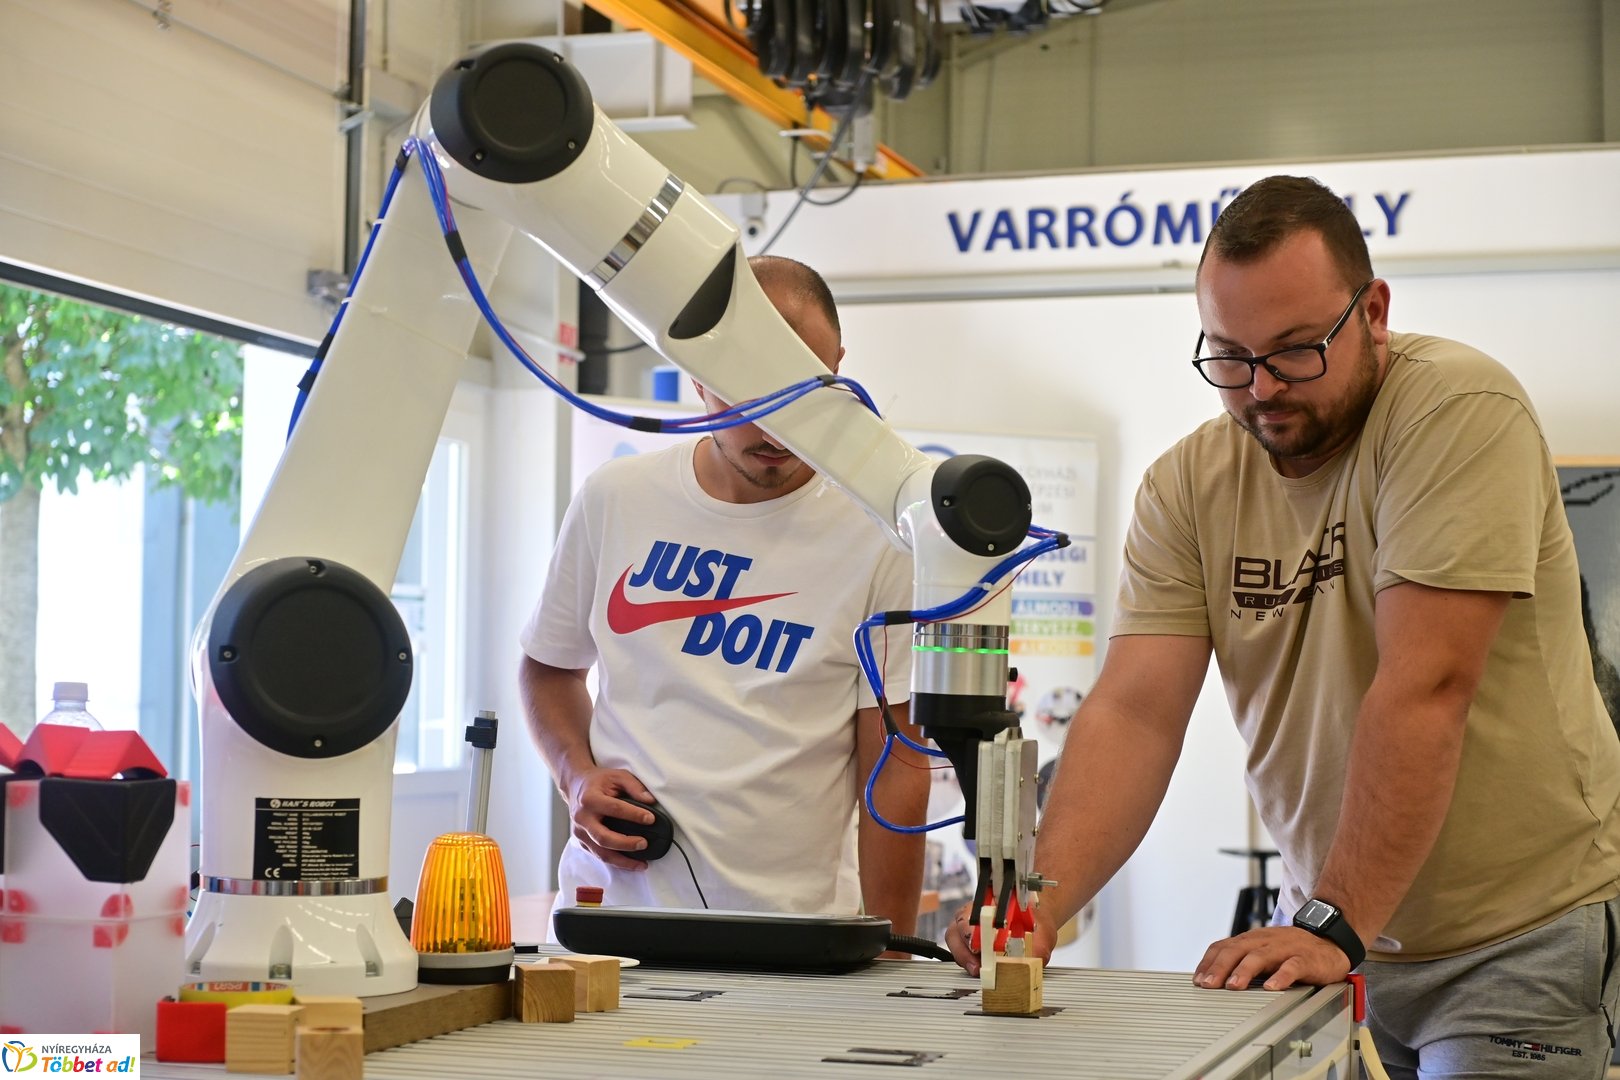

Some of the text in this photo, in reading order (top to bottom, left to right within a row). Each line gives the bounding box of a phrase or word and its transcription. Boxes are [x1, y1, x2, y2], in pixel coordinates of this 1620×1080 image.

[947, 188, 1411, 252] VARRÓMY
[628, 540, 753, 601] JUST
[1230, 607, 1285, 621] NEW
[309, 800, 336, 808] ROBOT
[1489, 1035, 1582, 1056] TOMMY HILFIGER
[1512, 1050, 1529, 1059] EST.
